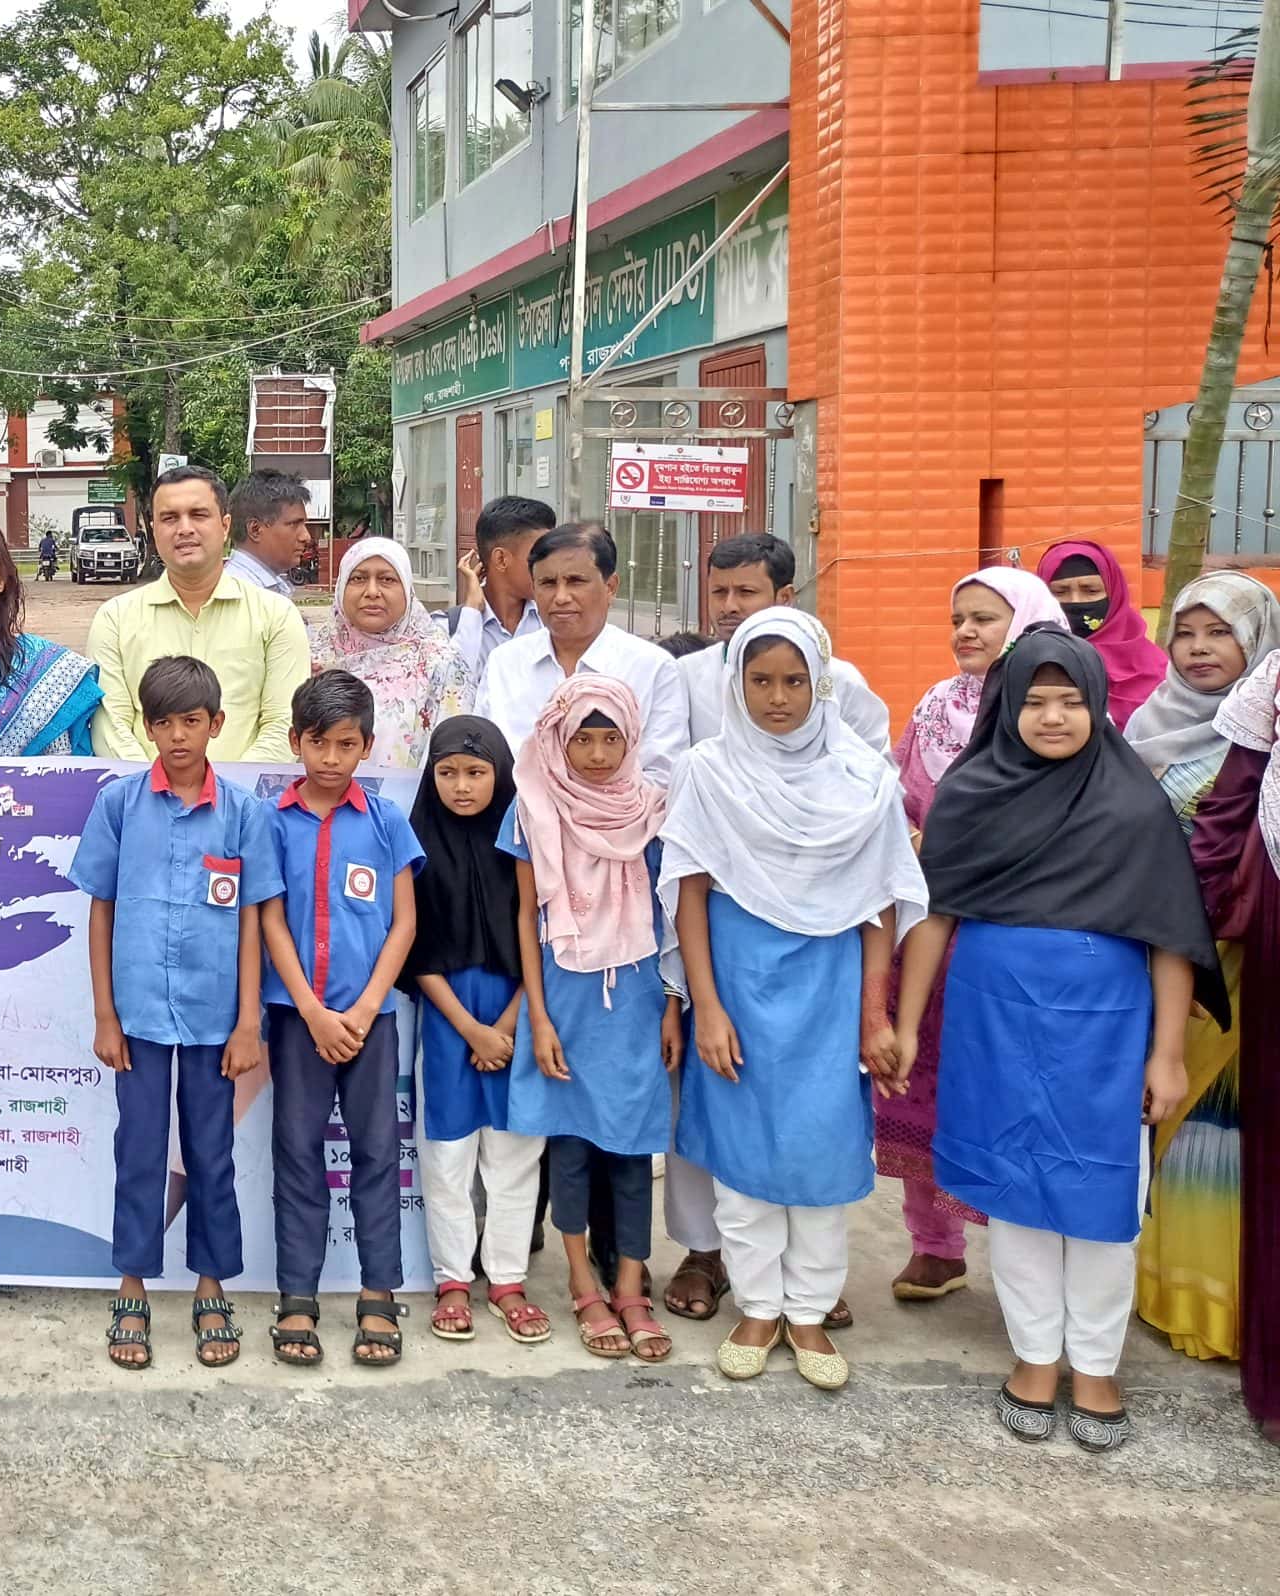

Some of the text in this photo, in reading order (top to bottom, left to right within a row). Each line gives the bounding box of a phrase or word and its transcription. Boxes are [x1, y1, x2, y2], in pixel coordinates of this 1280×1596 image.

[517, 296, 556, 351] উপজেলা
[607, 246, 648, 325] সেন্টার
[652, 229, 708, 329] (UDC)
[480, 310, 506, 364] Desk)
[586, 333, 637, 365] রাজাহী
[8, 1096, 69, 1115] রাজশাহী
[22, 1126, 81, 1146] রাজশাহী
